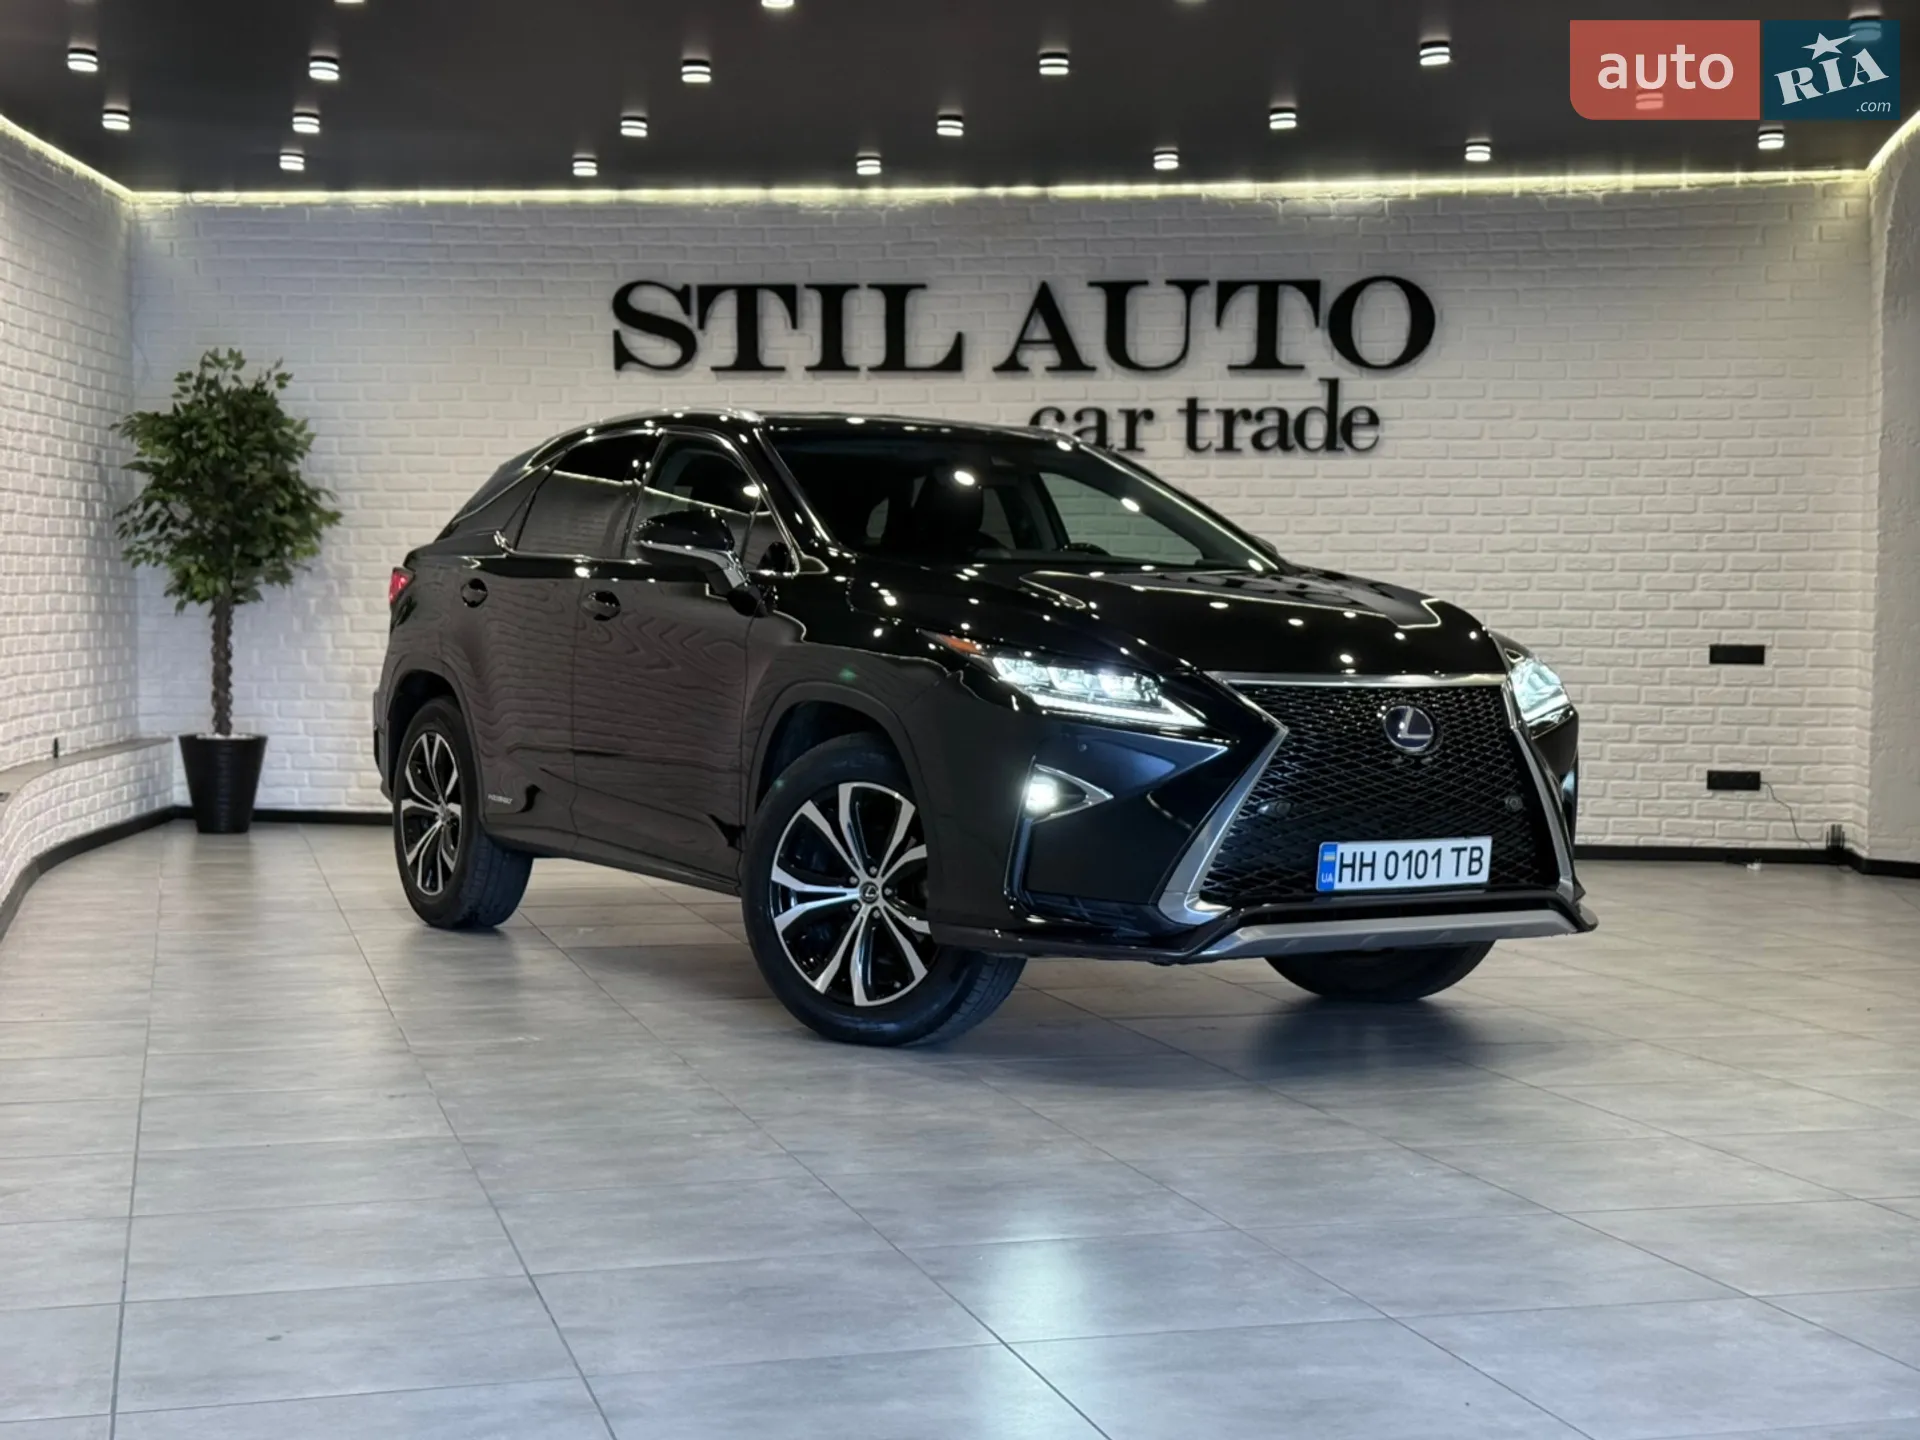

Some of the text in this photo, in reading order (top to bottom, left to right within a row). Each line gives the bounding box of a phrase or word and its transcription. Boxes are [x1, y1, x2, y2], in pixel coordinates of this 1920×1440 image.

[612, 276, 1436, 373] STIL AUTO
[1178, 377, 1380, 455] trade
[1321, 873, 1334, 884] UA
[1338, 846, 1484, 883] HH 0101 TB
